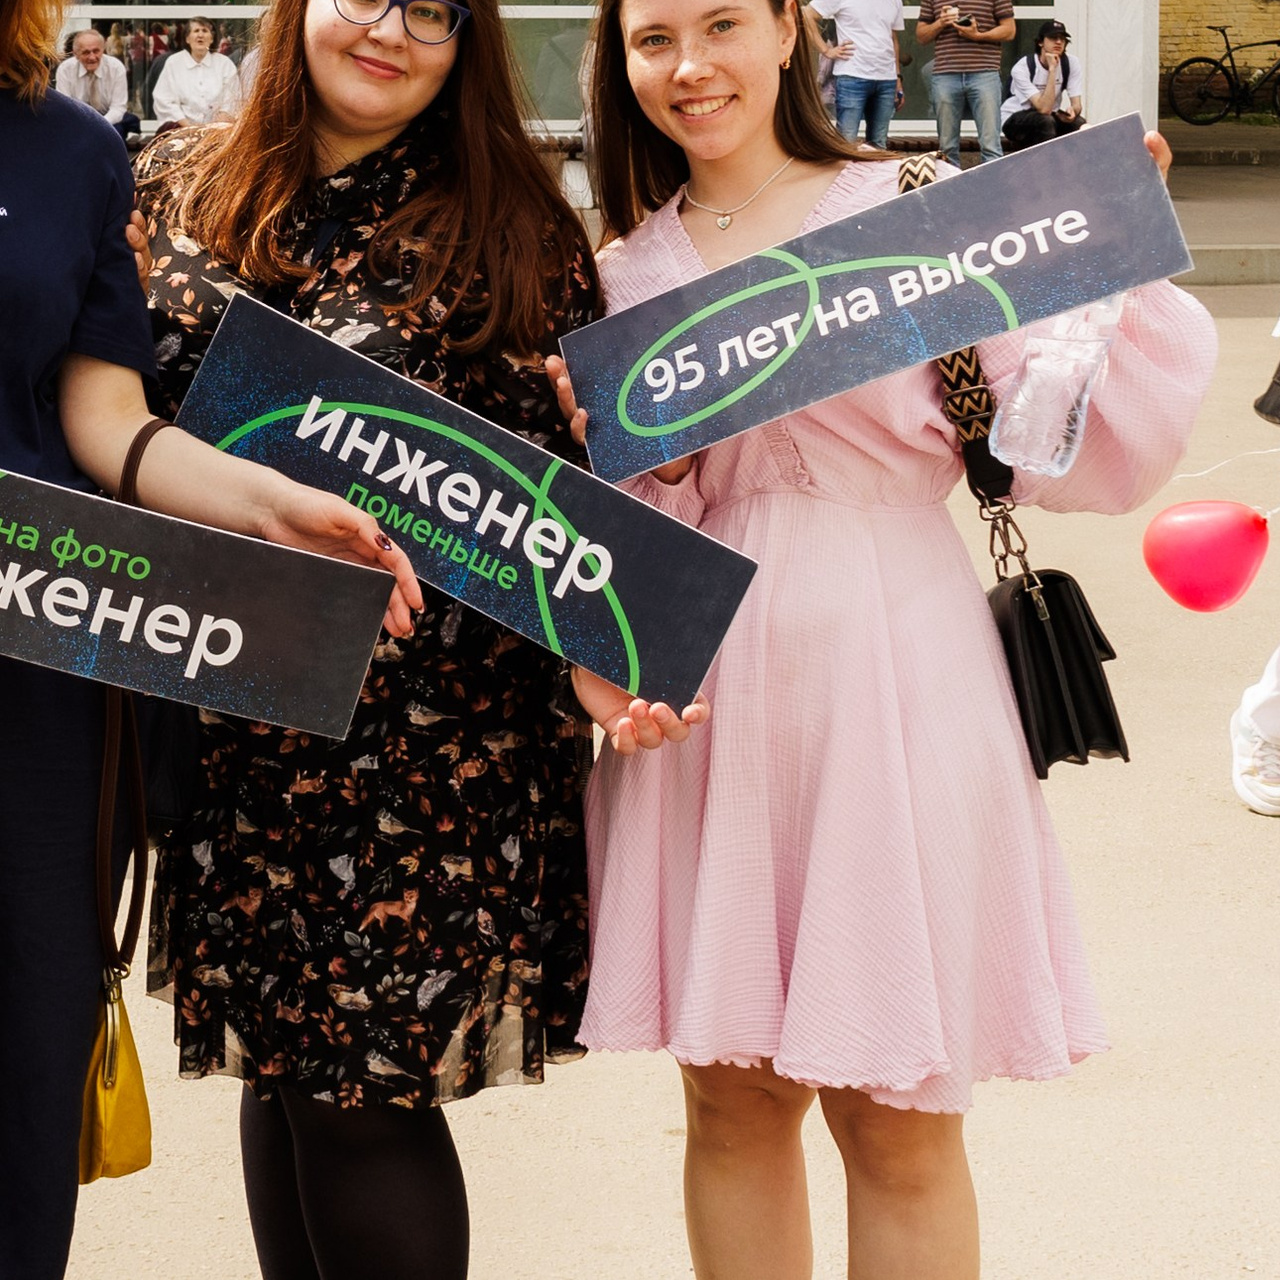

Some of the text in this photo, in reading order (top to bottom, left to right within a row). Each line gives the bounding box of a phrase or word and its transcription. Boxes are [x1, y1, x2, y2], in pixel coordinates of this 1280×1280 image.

[644, 209, 1091, 403] 95 лет на высоте
[50, 529, 151, 580] фото
[295, 394, 613, 599] инженер
[346, 482, 519, 590] поменьше
